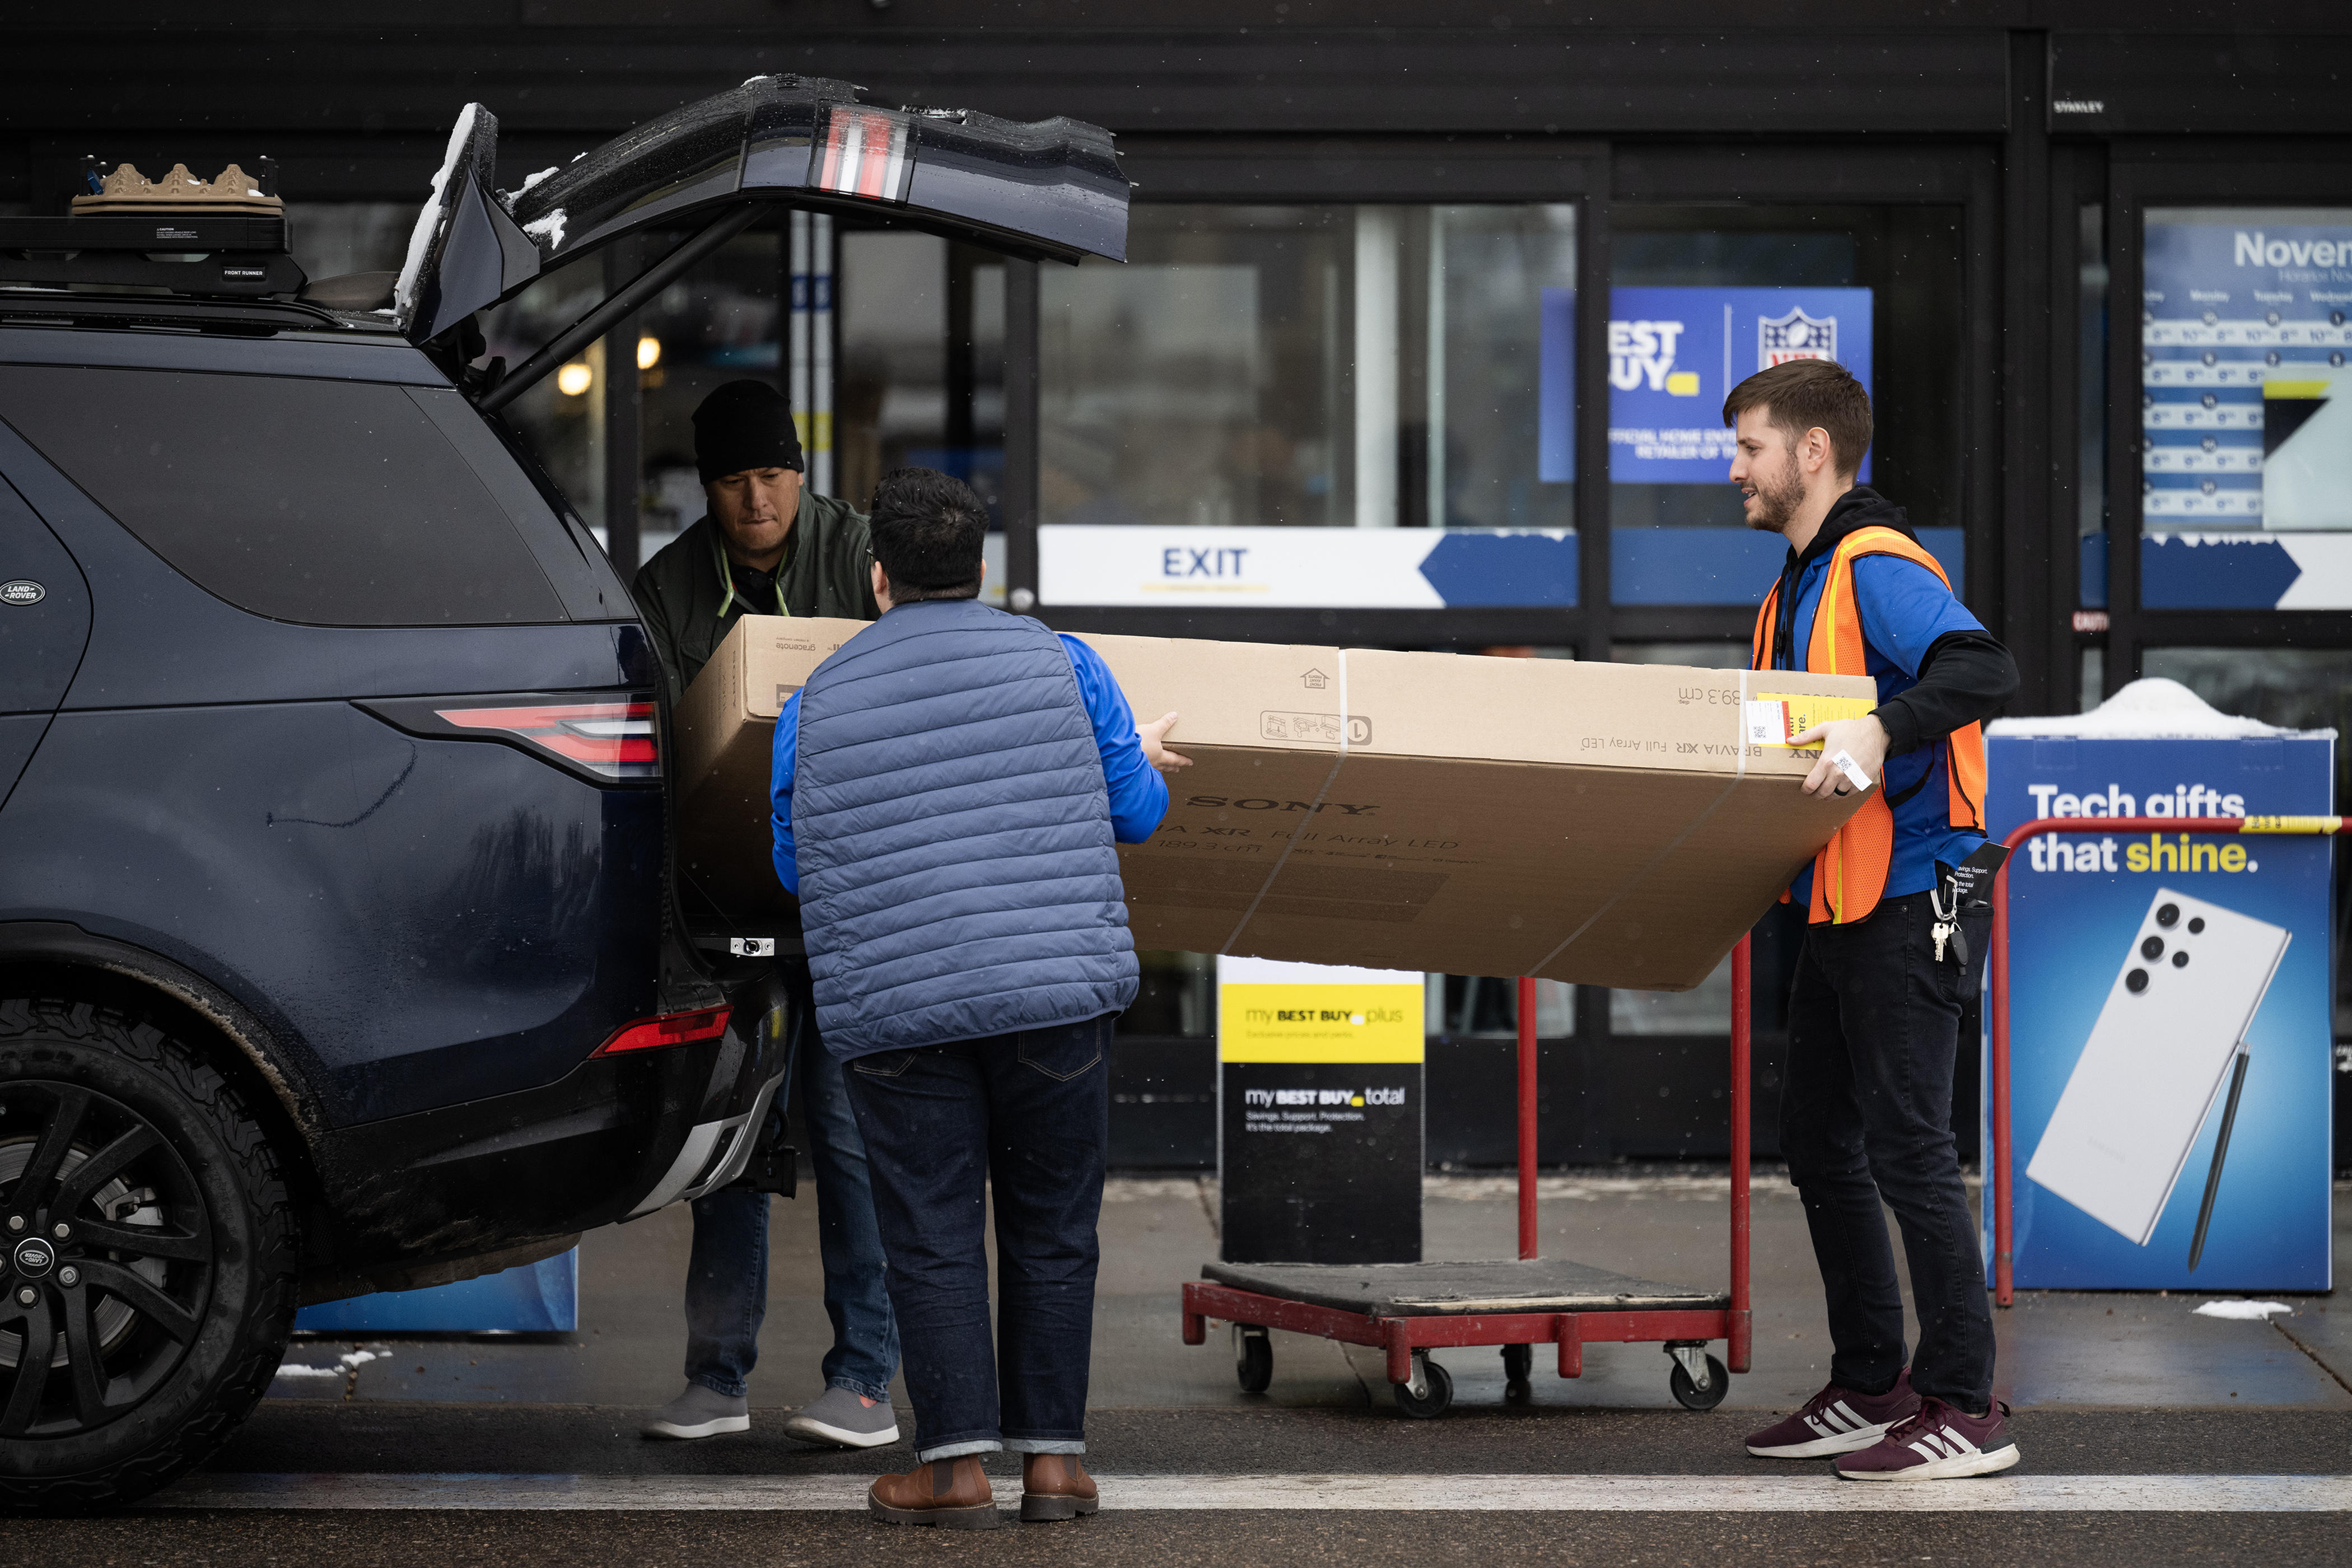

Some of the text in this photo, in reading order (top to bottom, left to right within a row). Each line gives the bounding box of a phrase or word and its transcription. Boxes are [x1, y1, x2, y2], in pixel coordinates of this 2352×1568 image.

[1608, 320, 1684, 355] EST
[1608, 354, 1676, 391] UY
[1164, 548, 1248, 577] EXIT
[776, 642, 816, 651] gracenote
[1679, 688, 1703, 700] cm
[1609, 736, 1641, 750] Array
[1645, 740, 1667, 752] Full
[1676, 742, 1699, 754] XR
[1704, 744, 1762, 757] BRAVIA
[1187, 796, 1381, 816] SONY
[2028, 783, 2246, 819] Tech gifts
[1271, 831, 1318, 841] Full
[1328, 834, 1399, 847] Array
[1407, 839, 1459, 849] LED
[1223, 844, 1261, 853] cm
[2028, 833, 2258, 873] that shine.
[1245, 1006, 1404, 1026] my BEST BUY plus
[1246, 1030, 1284, 1039] Exclusive
[1245, 1087, 1405, 1108] my BEST BUY total
[1245, 1110, 1365, 1122] Savings. Support. Protection.
[1245, 1123, 1332, 1133] It's the total package.
